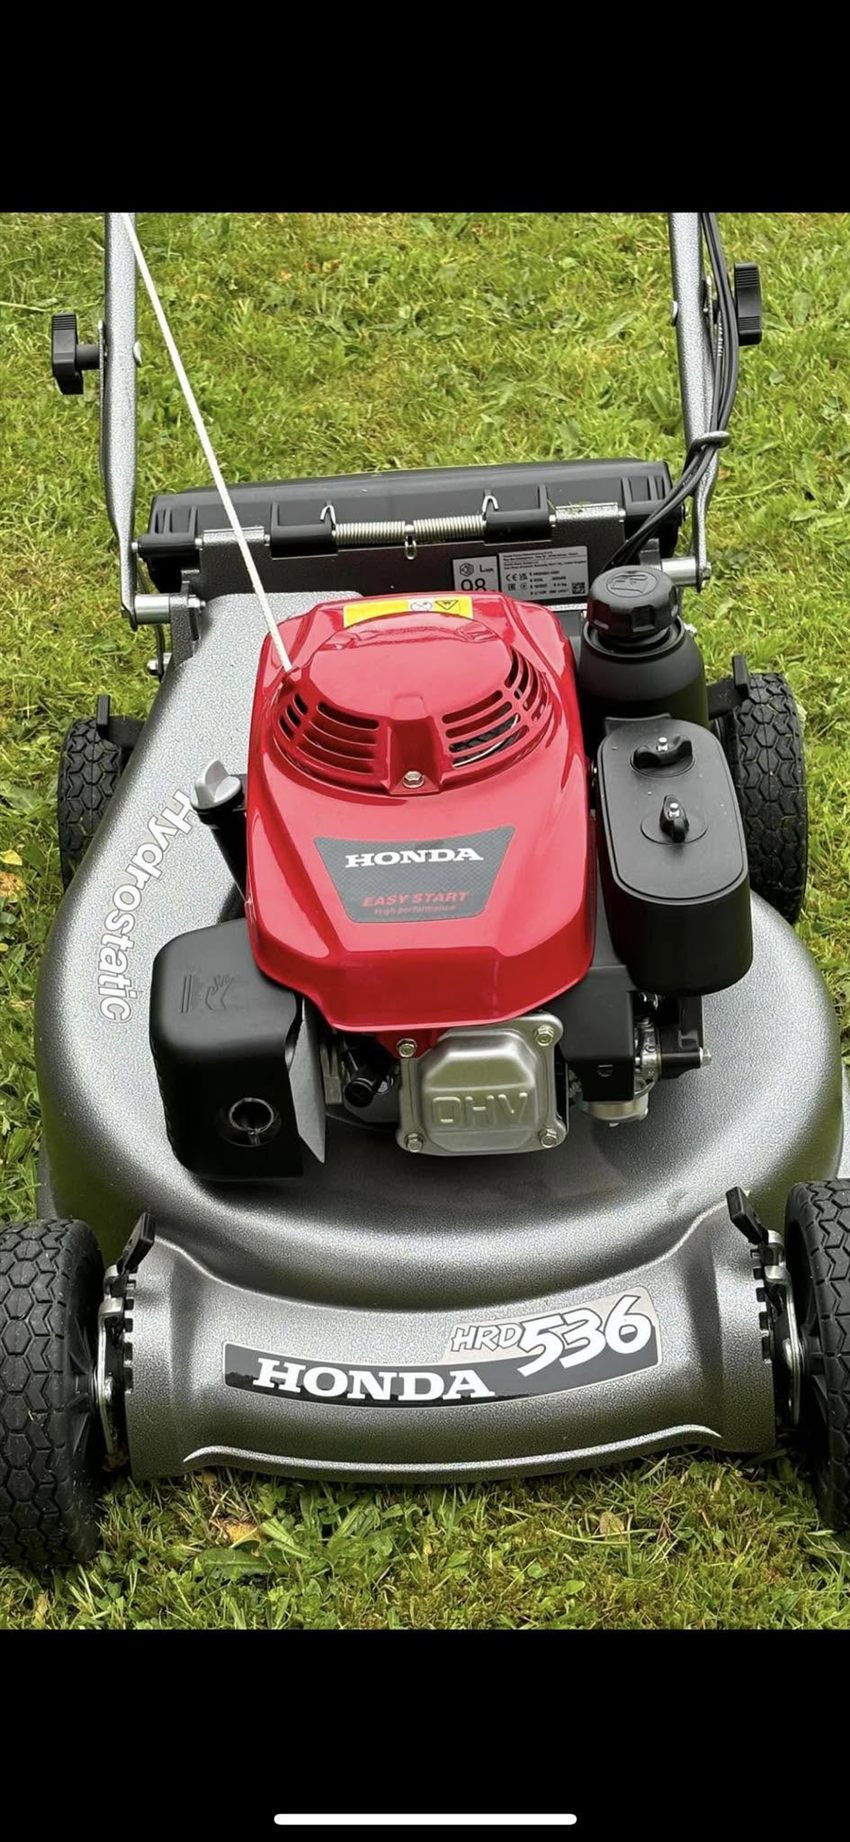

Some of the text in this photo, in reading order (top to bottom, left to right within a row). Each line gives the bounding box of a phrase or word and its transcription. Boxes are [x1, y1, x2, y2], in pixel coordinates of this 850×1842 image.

[344, 847, 484, 869] HONDA
[98, 788, 198, 1023] Hydrostatic
[361, 890, 470, 908] EASY START
[432, 1091, 529, 1126] OHV
[252, 1357, 496, 1401] HONDA
